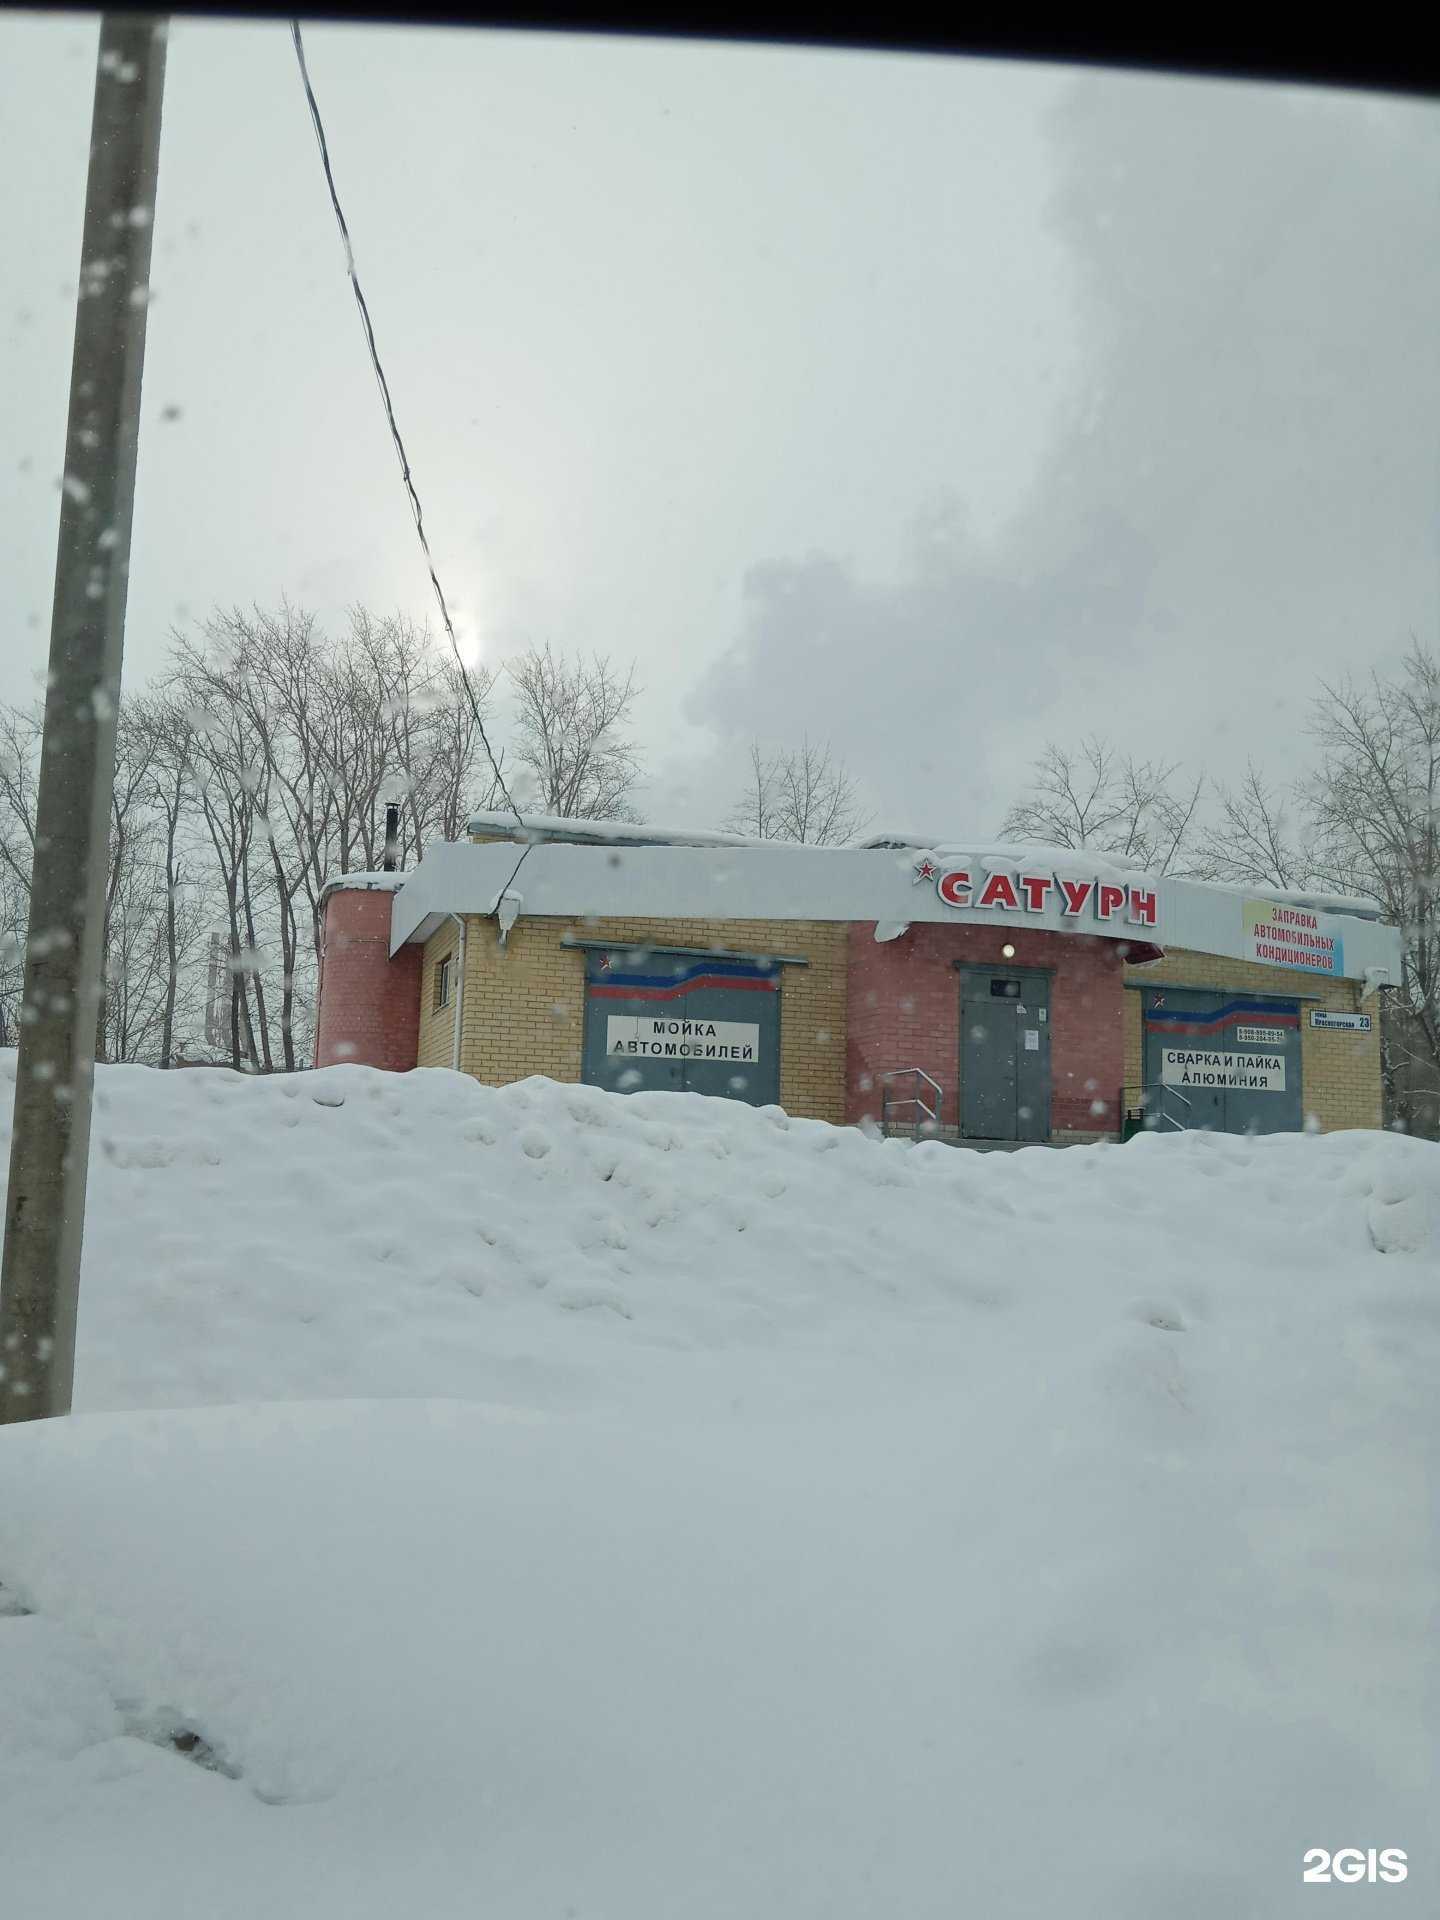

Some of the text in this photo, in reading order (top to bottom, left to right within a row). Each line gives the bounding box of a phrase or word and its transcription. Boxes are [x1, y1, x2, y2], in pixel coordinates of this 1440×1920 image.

[938, 871, 1157, 927] САТУРН
[1272, 907, 1318, 929] ЗАПРАВКА
[1254, 923, 1335, 951] АВТОМОБИЛЬНЫХ
[1256, 943, 1334, 970] КОНДИЦИОНЕРОВ
[653, 1019, 717, 1037] МОЙКА
[1359, 1016, 1370, 1028] 23
[613, 1040, 753, 1060] АВТОМОБИЛЕЙ
[1167, 1052, 1281, 1070] СВАРКА И ПАЙКА
[1181, 1071, 1268, 1088] АЛЮМИНИЯ
